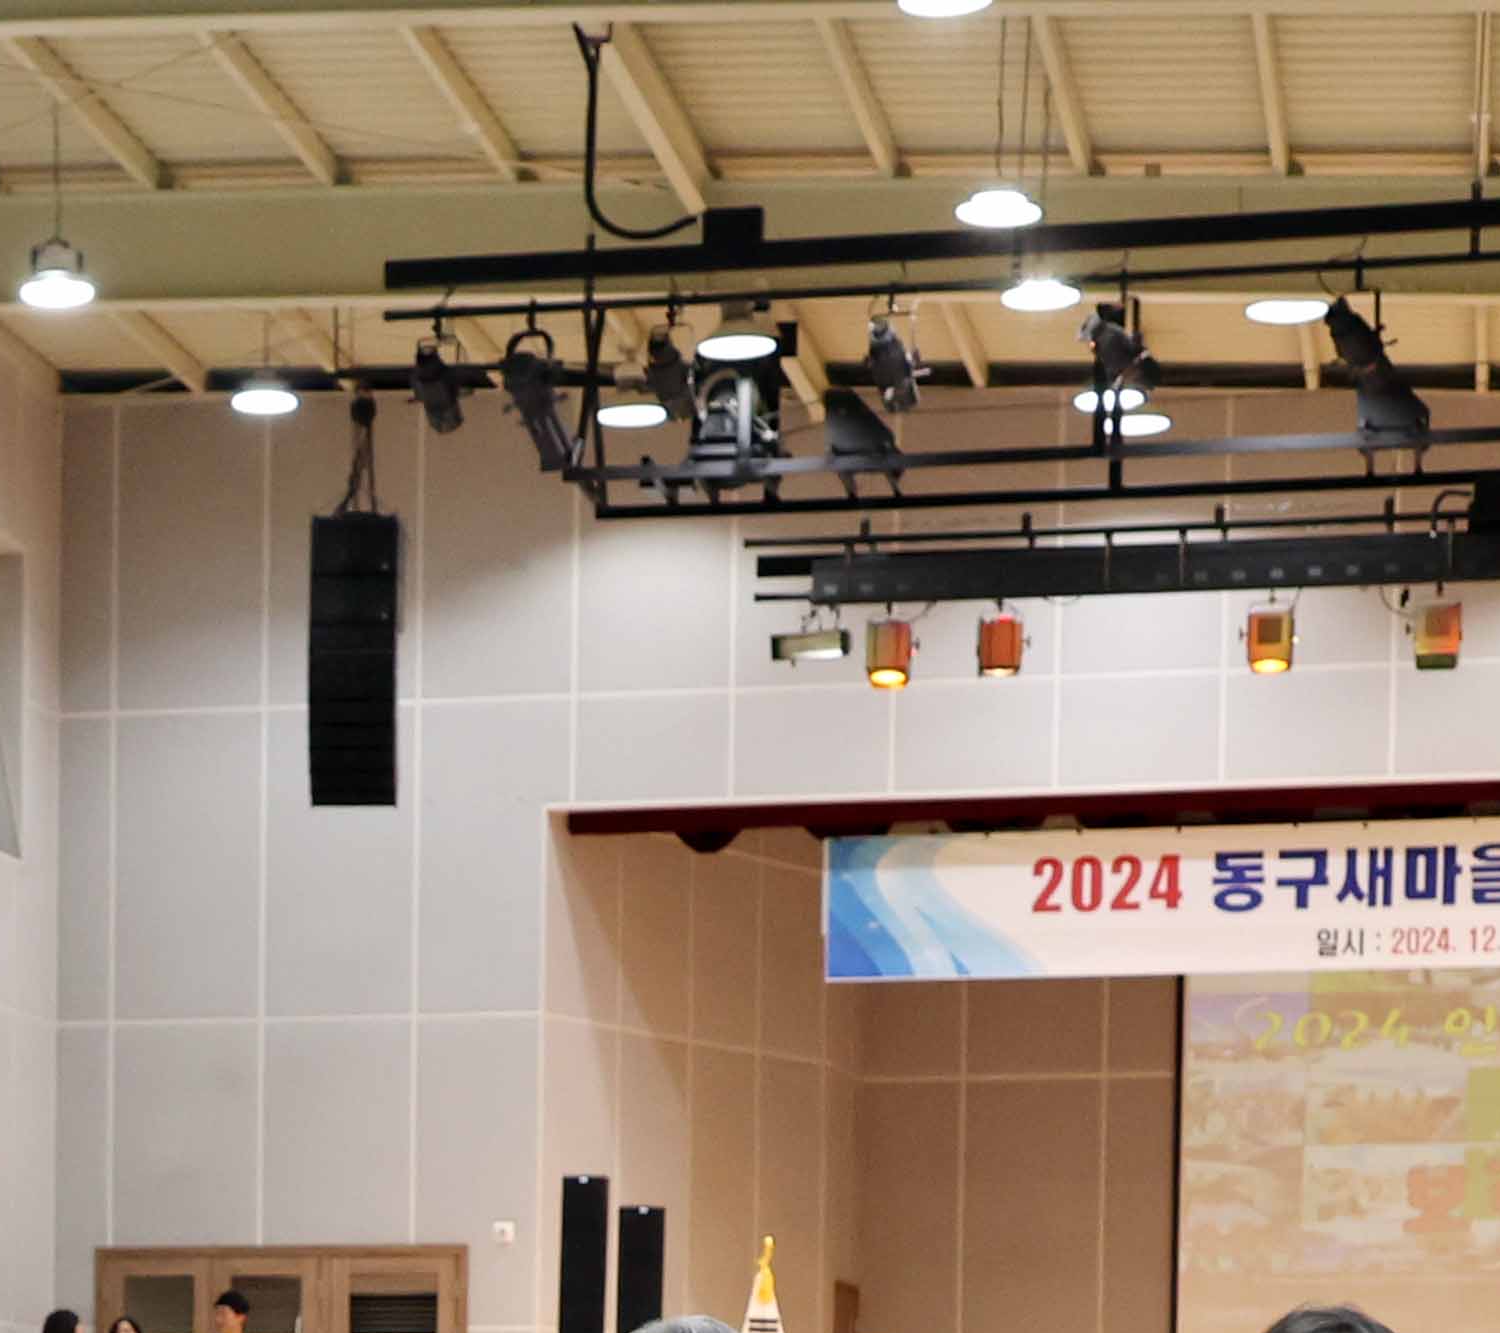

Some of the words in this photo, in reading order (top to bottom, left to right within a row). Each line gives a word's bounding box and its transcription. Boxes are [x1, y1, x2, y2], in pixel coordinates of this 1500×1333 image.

[1032, 854, 1182, 913] 2024
[1317, 927, 1365, 957] 일시
[1390, 926, 1456, 956] 2024.
[1254, 1007, 1410, 1051] 2024
